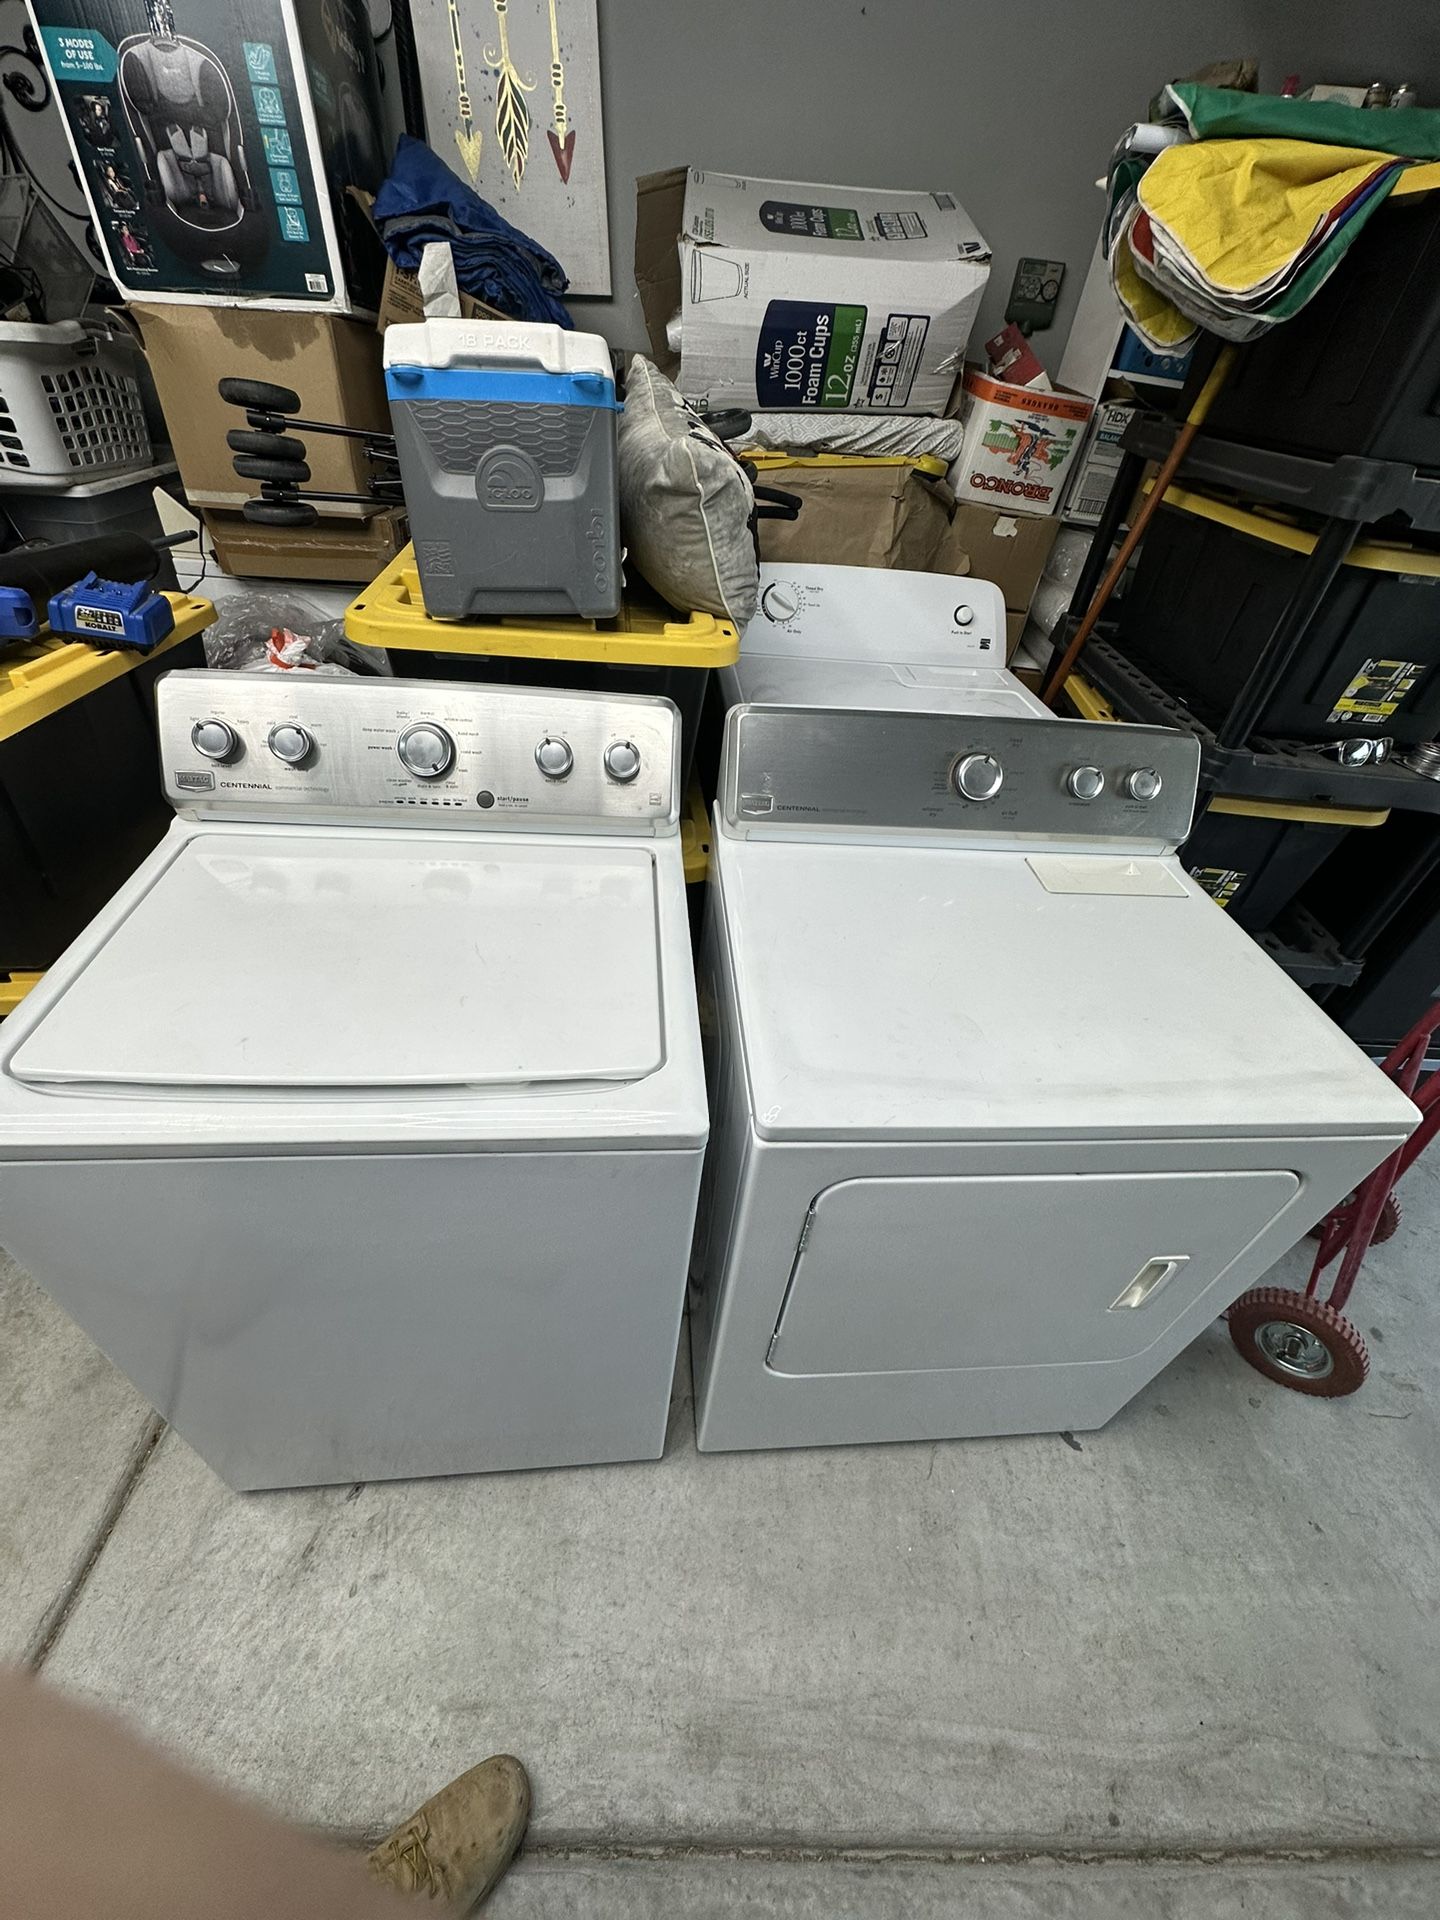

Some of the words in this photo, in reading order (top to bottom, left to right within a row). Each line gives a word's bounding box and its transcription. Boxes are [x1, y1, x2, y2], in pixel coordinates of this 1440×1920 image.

[65, 38, 94, 49] MODES
[65, 50, 76, 60] OF
[77, 51, 94, 60] USE
[458, 334, 478, 347] 18
[484, 336, 531, 350] PACK
[809, 314, 831, 359] Cups
[770, 340, 784, 380] WinCup
[802, 363, 822, 404] Foam
[1106, 411, 1131, 425] HDX
[487, 487, 534, 500] IGLOO
[970, 473, 1054, 501] BRONCO
[84, 621, 116, 632] KOBALT
[220, 782, 272, 790] CENTENNIAL
